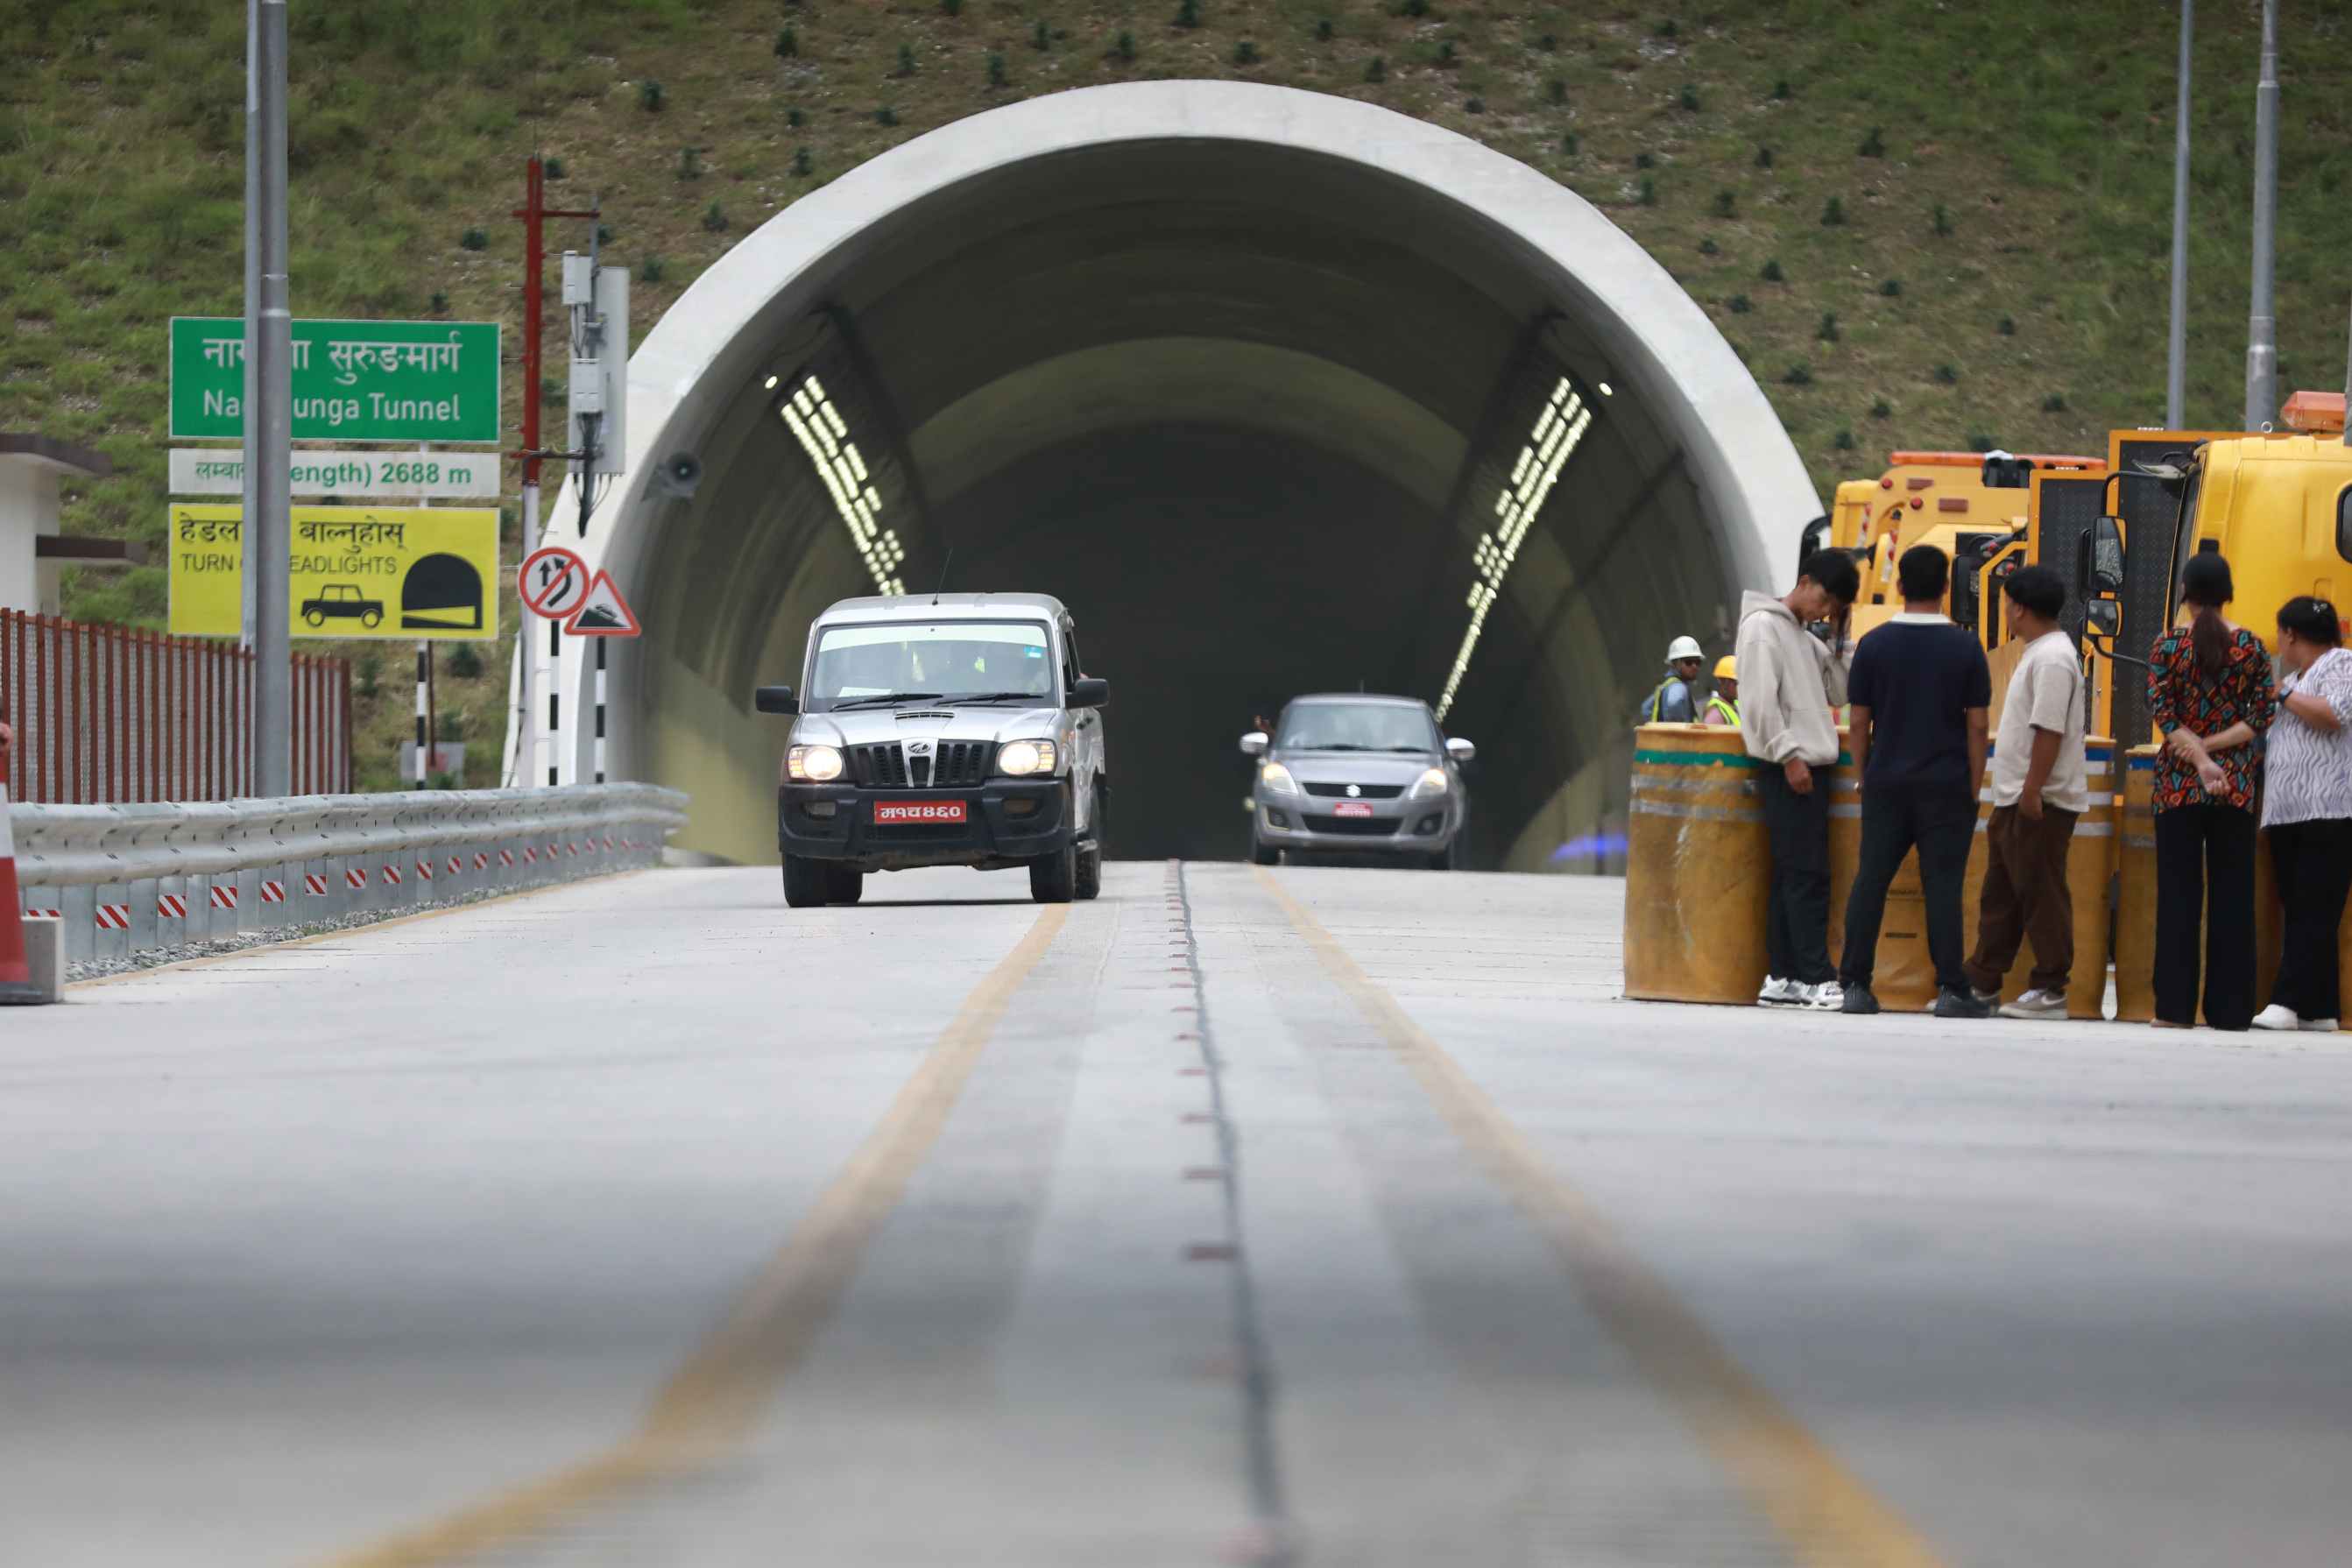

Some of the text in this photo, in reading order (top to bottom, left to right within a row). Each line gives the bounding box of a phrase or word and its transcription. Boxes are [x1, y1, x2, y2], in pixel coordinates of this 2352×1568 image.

[203, 390, 461, 426] Naunga Tunnel
[195, 462, 244, 480] लम्बा
[291, 462, 471, 488] ength) 2688 m
[180, 553, 234, 572] TURN
[290, 554, 397, 576] EADLIGHTS
